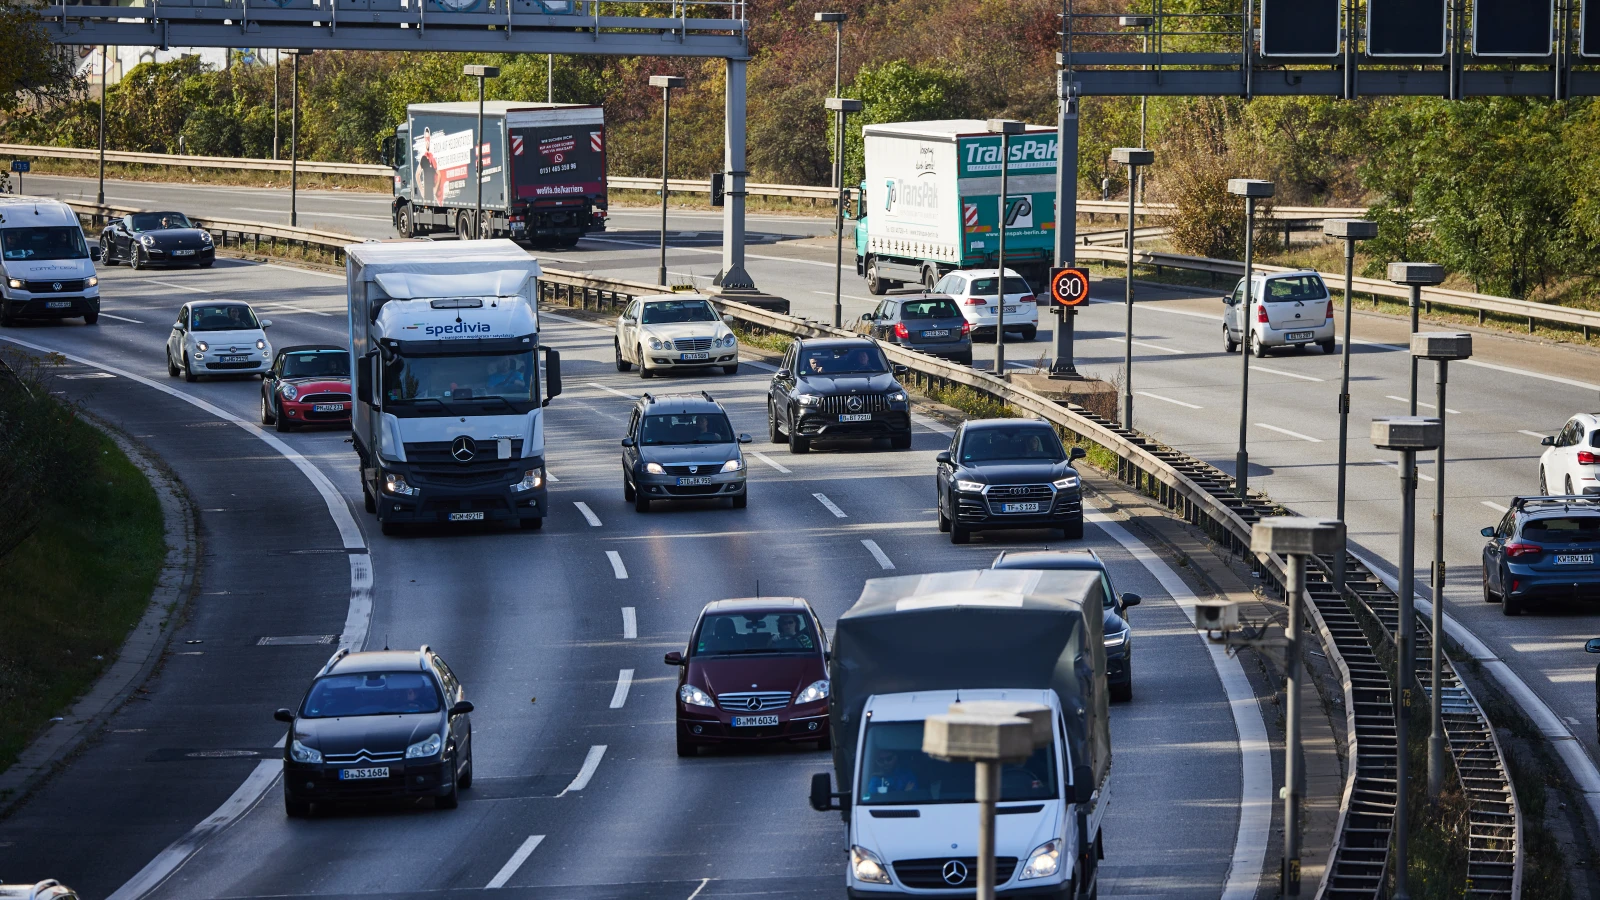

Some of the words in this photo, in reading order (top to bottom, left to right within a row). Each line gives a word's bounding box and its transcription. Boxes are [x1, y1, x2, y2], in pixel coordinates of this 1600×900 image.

[898, 179, 938, 208] TransPak
[1060, 278, 1080, 296] 80
[425, 322, 491, 337] spedivia
[1402, 689, 1410, 698] 75
[758, 716, 777, 724] 6034
[367, 768, 387, 777] 1684
